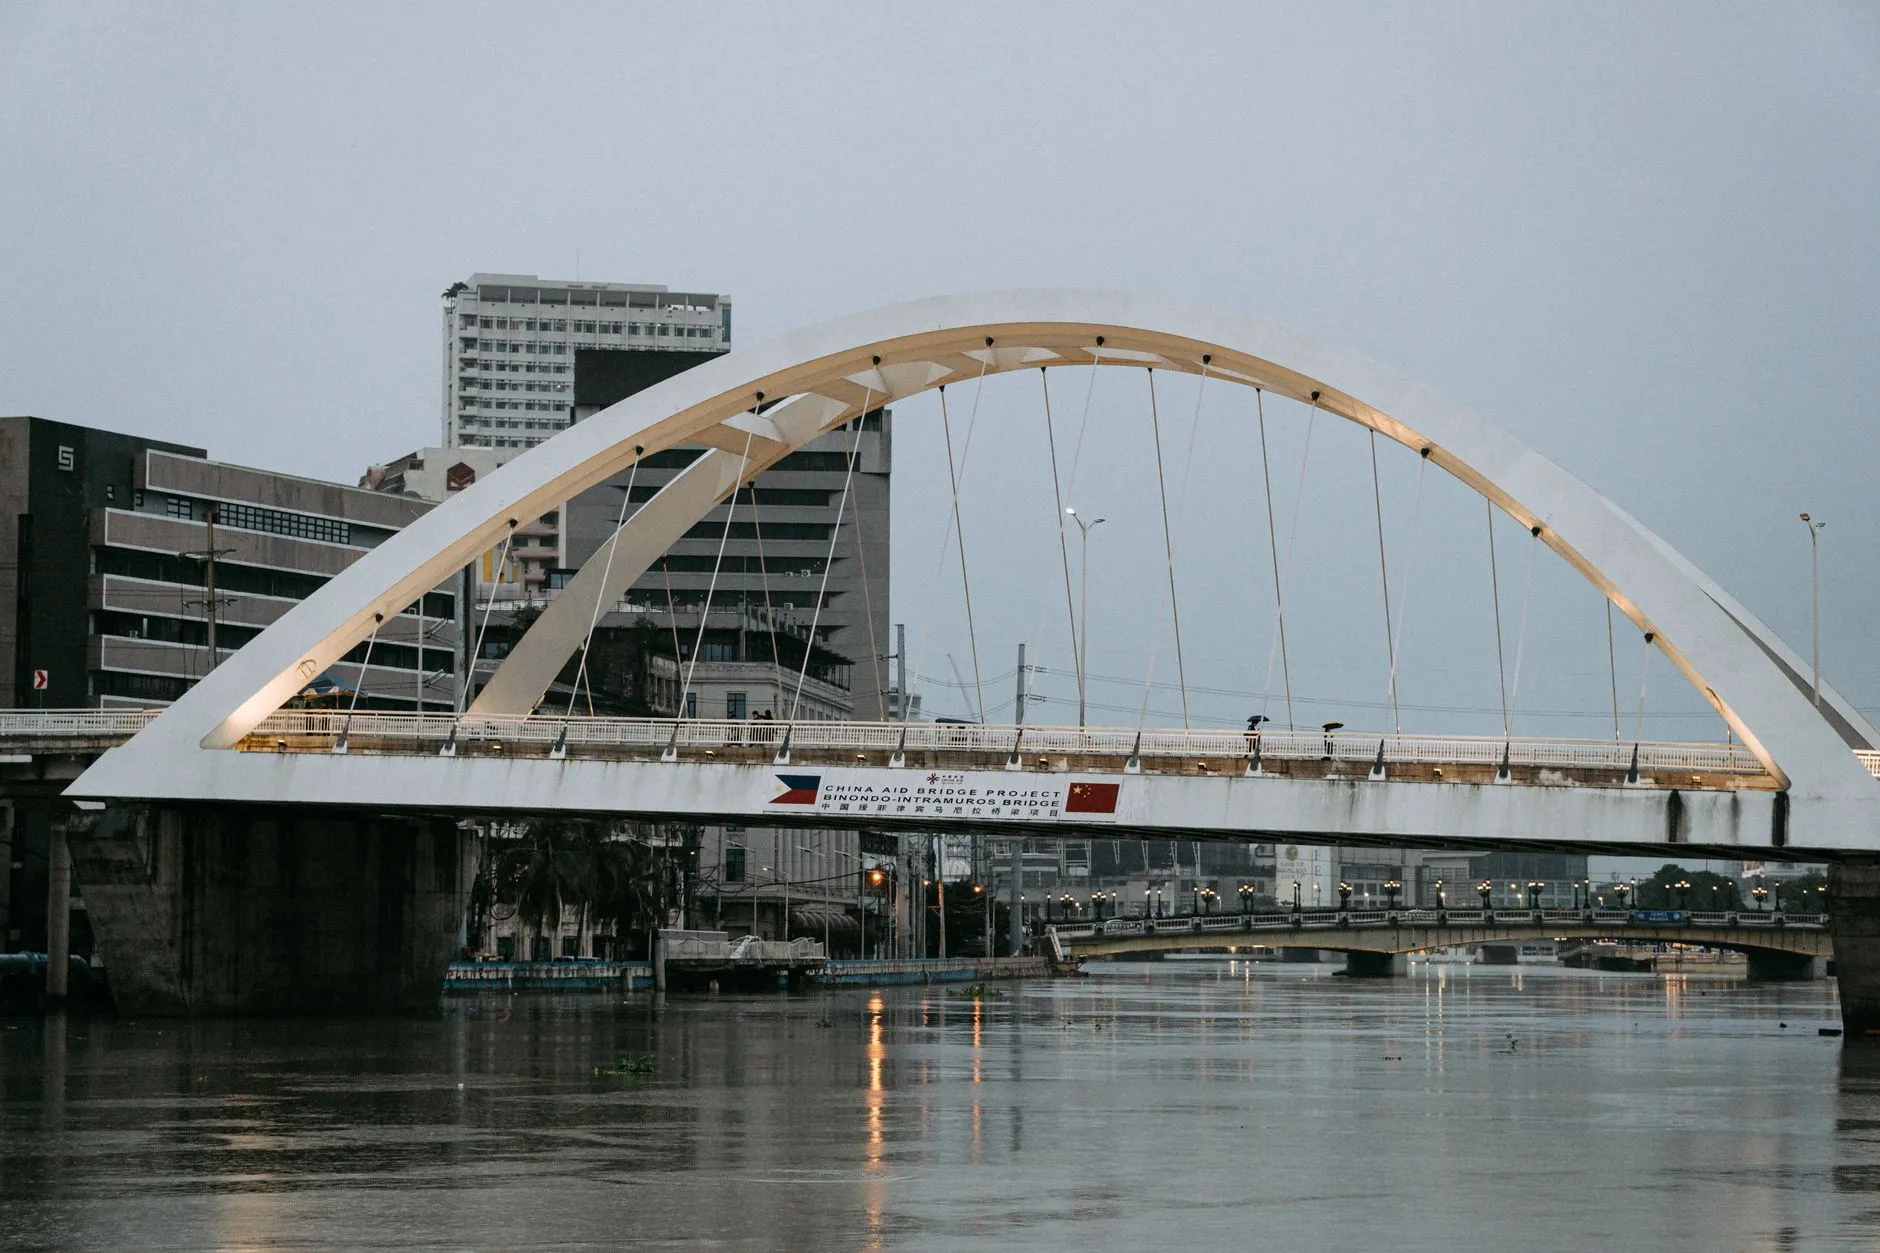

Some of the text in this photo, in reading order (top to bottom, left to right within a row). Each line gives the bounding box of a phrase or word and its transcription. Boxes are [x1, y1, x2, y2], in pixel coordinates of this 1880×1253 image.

[825, 785, 873, 793] CHINA
[917, 787, 977, 796] BRIDGE
[986, 789, 1061, 798] PROJECT
[823, 794, 1060, 807] BINONDO-INTRAMUROS BRIDGE
